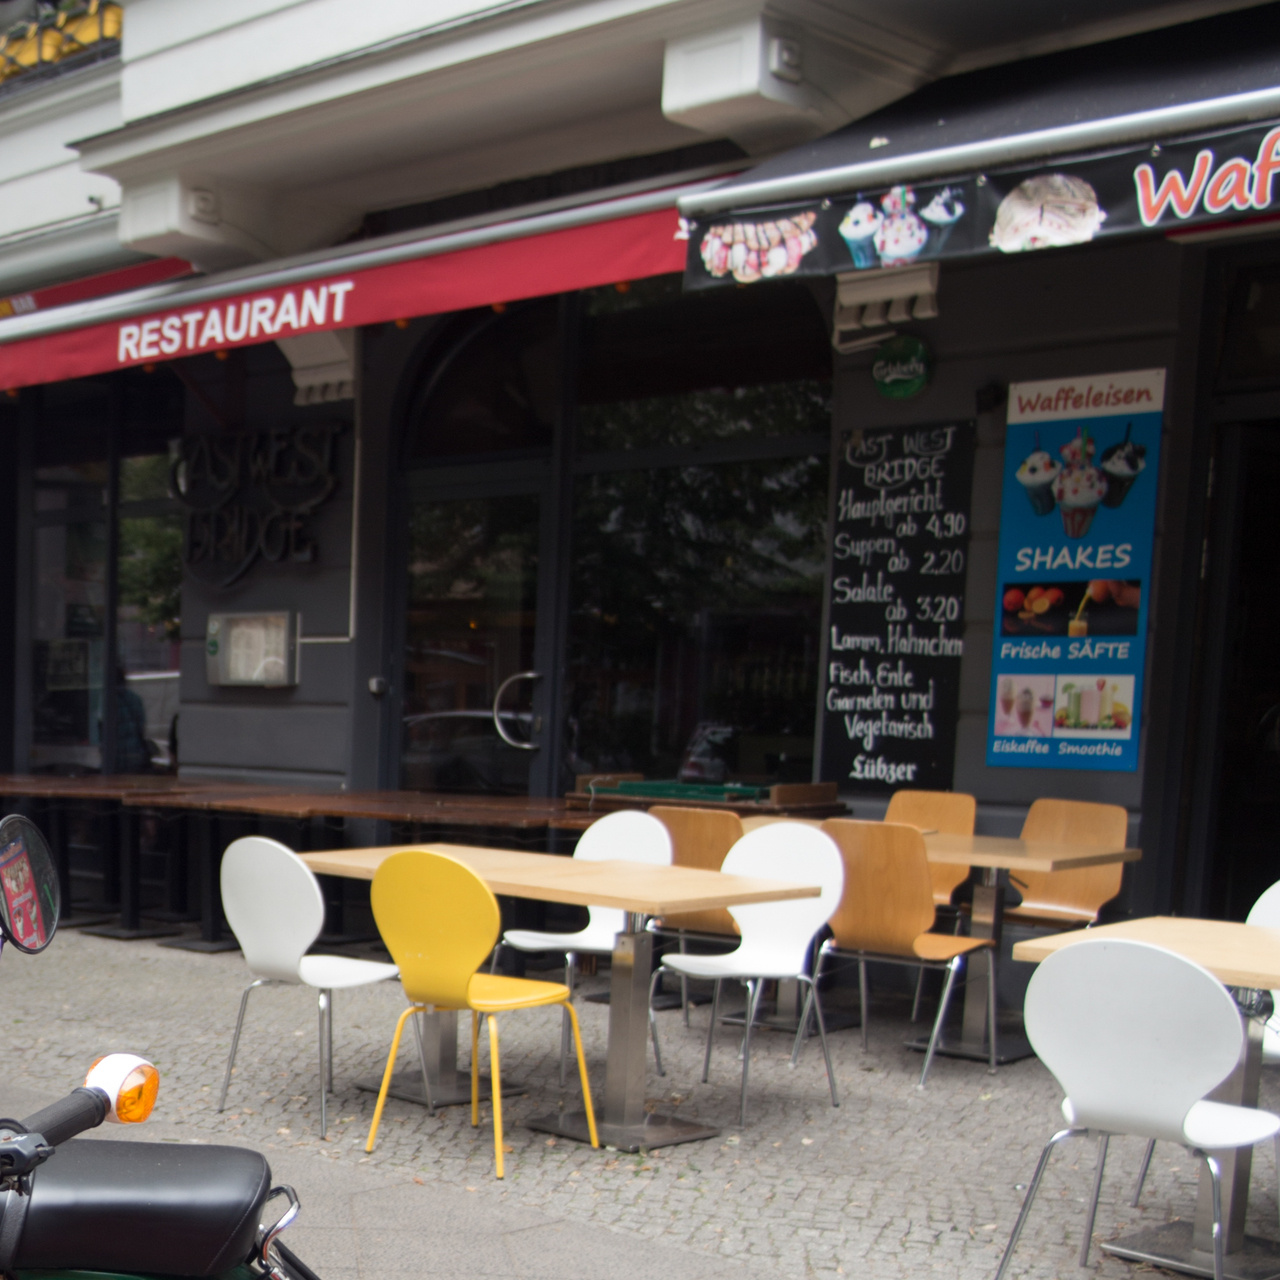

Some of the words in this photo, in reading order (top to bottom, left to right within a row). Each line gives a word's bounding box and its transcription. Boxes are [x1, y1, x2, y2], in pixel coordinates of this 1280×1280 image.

[118, 281, 354, 362] RESTAURANT
[1017, 383, 1152, 415] Waffeleisen
[903, 426, 956, 456] WEST
[864, 455, 945, 490] BRIDGE
[896, 515, 918, 538] ab
[833, 533, 896, 566] Suppen
[888, 548, 910, 573] ab
[1014, 543, 1132, 572] SHAKES
[833, 571, 894, 604] Salate
[885, 598, 908, 621] ab
[1000, 641, 1061, 660] Frische
[1068, 638, 1131, 660] SÄFTE
[826, 686, 895, 711] Garnelen
[901, 678, 934, 710] und
[844, 710, 934, 751] Vegetarisch
[993, 739, 1050, 753] Eiskaffee
[1058, 741, 1123, 756] Smoothie
[848, 754, 918, 784] Lübzer
